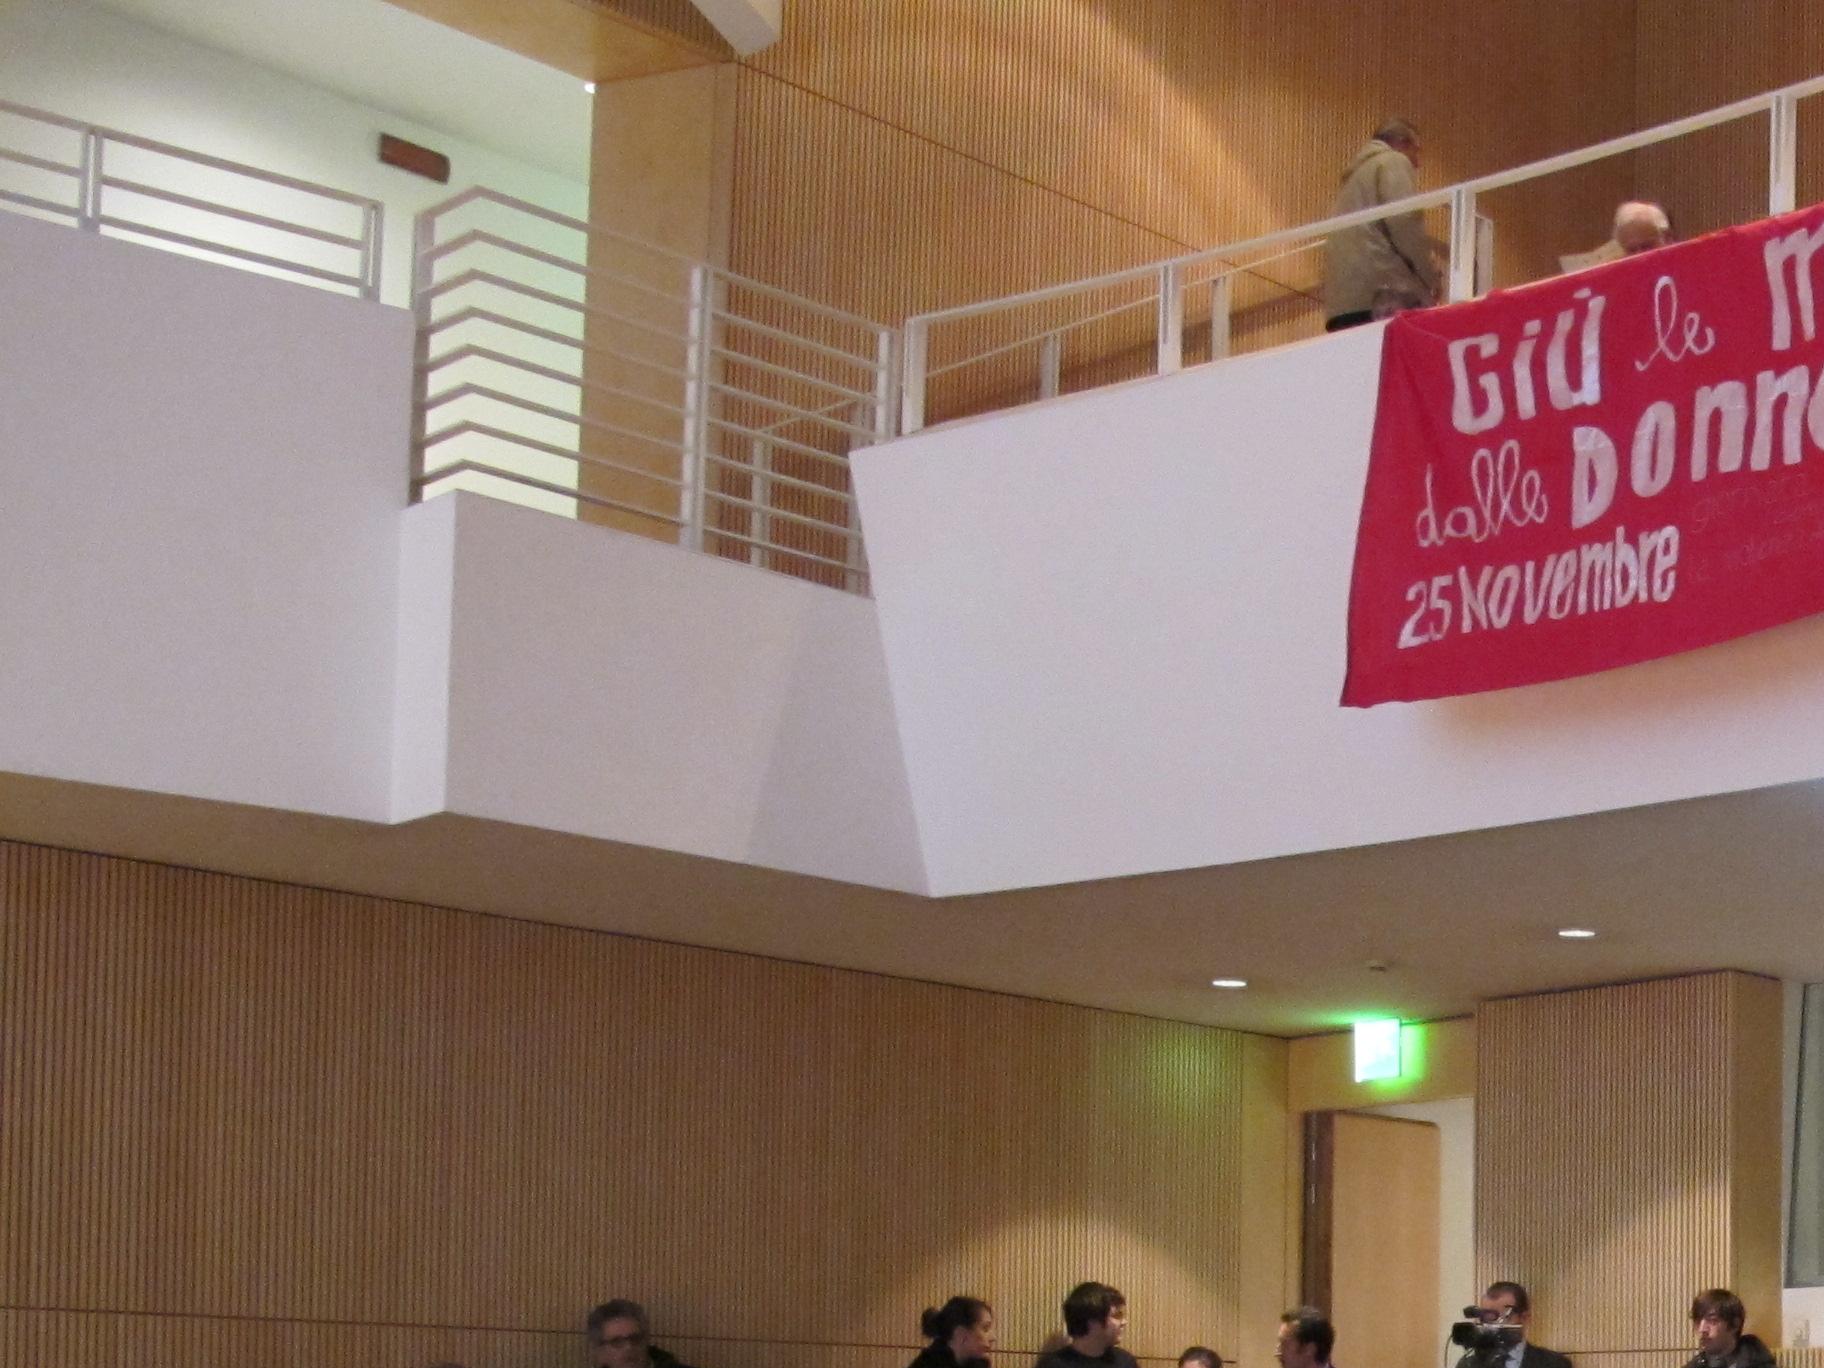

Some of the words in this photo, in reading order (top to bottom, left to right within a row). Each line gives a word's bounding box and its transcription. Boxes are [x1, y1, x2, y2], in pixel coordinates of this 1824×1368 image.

[1634, 275, 1715, 372] le
[1416, 439, 1549, 547] dalle
[1397, 575, 1453, 650] 25
